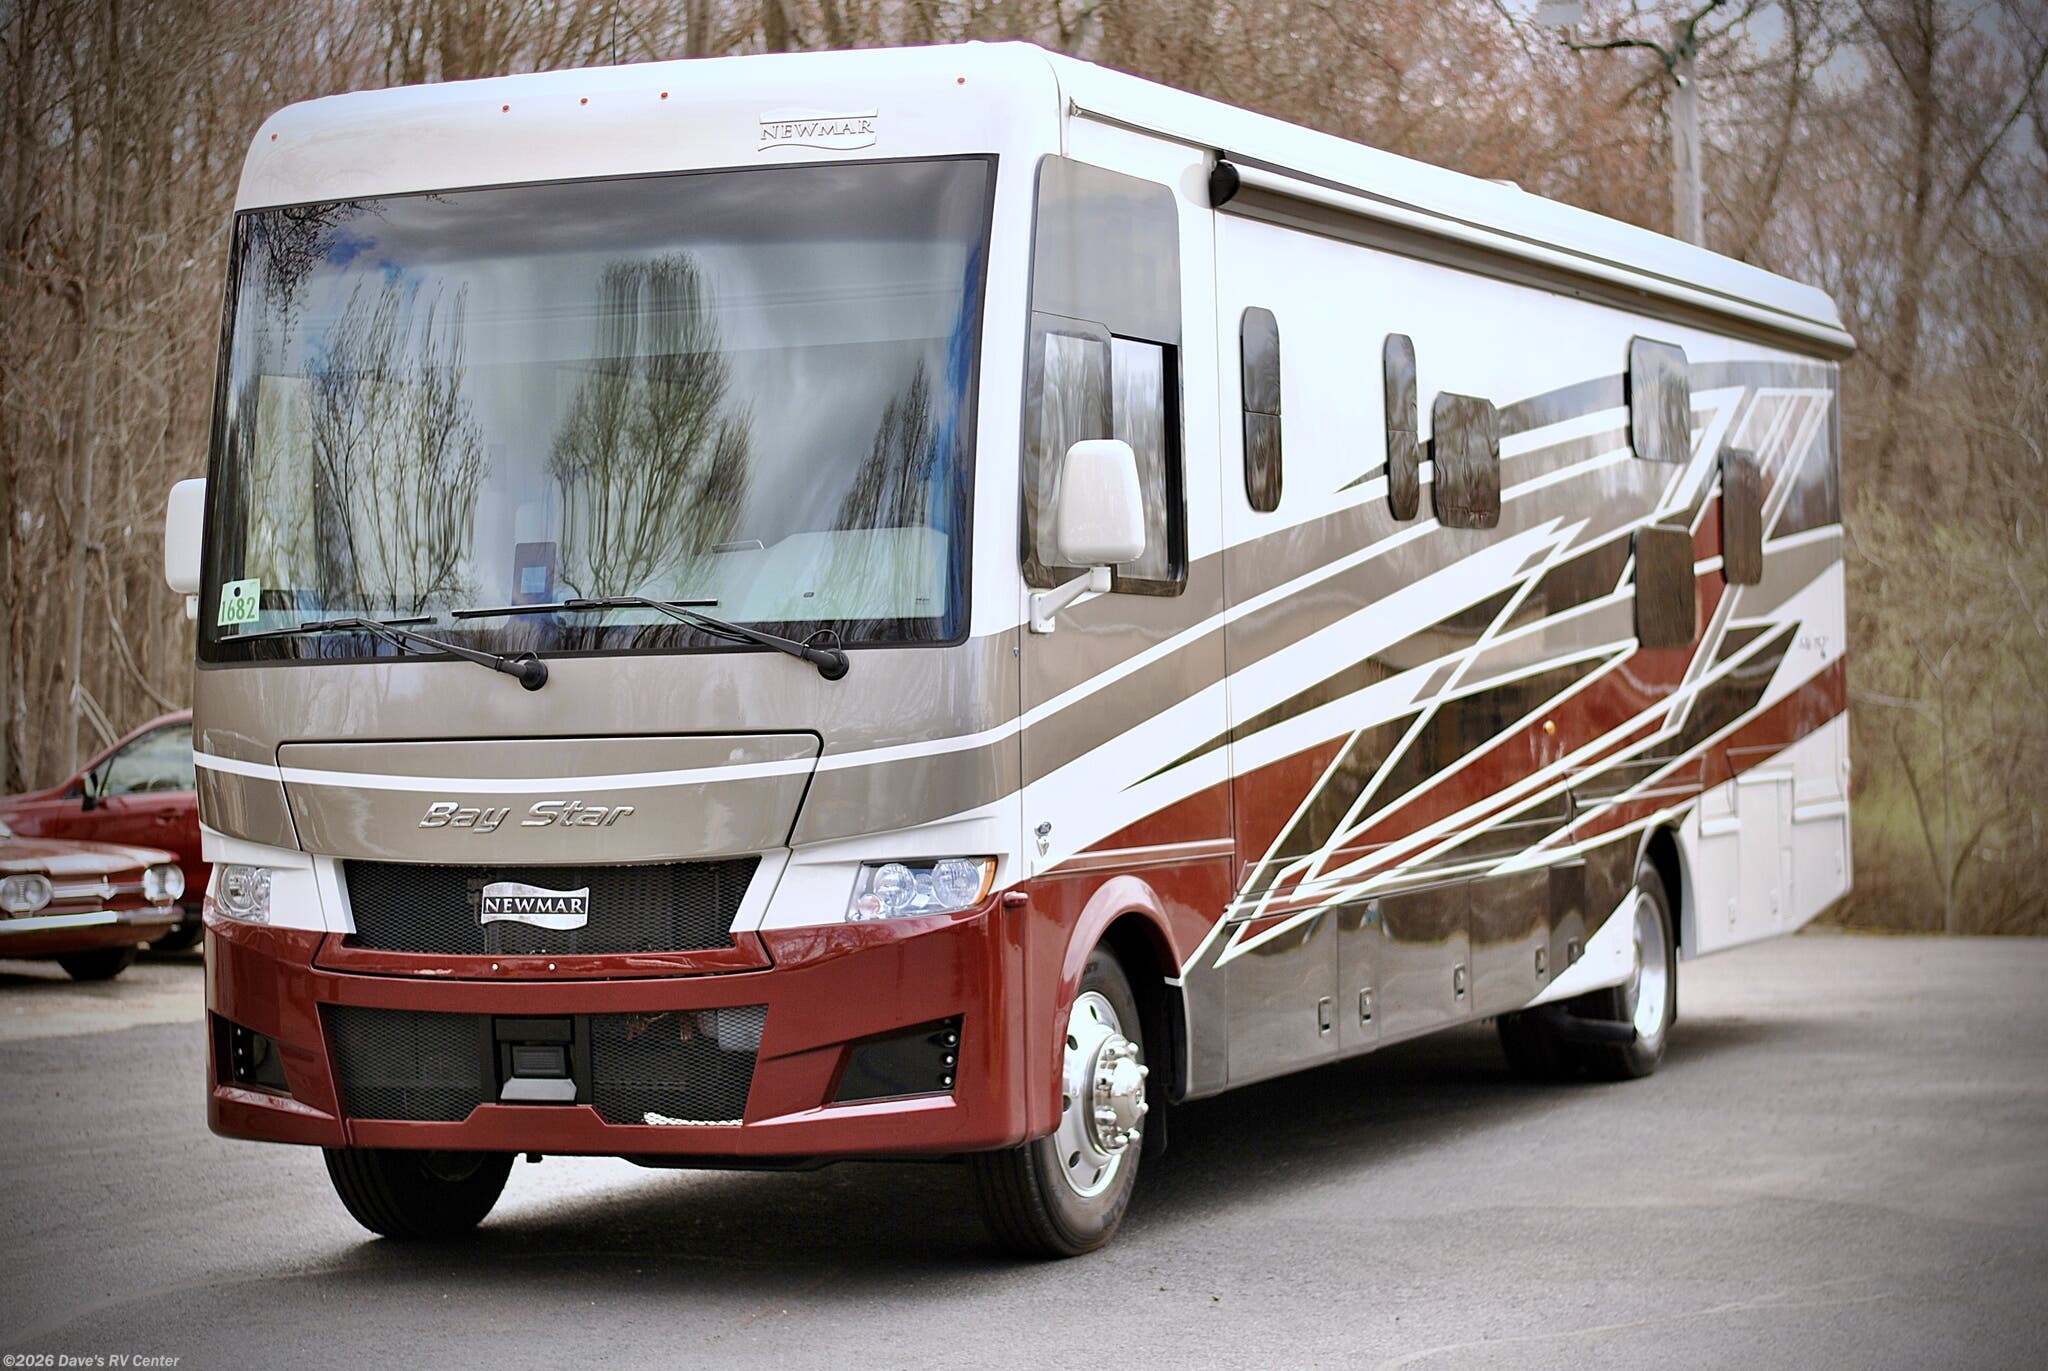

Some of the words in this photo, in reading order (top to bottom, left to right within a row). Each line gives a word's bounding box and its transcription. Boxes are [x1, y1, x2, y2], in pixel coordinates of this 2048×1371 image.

[760, 120, 875, 141] NEWMAR
[221, 596, 256, 623] 1682
[418, 801, 511, 835] Bay
[520, 800, 635, 828] Star
[484, 898, 584, 913] NEWMAR
